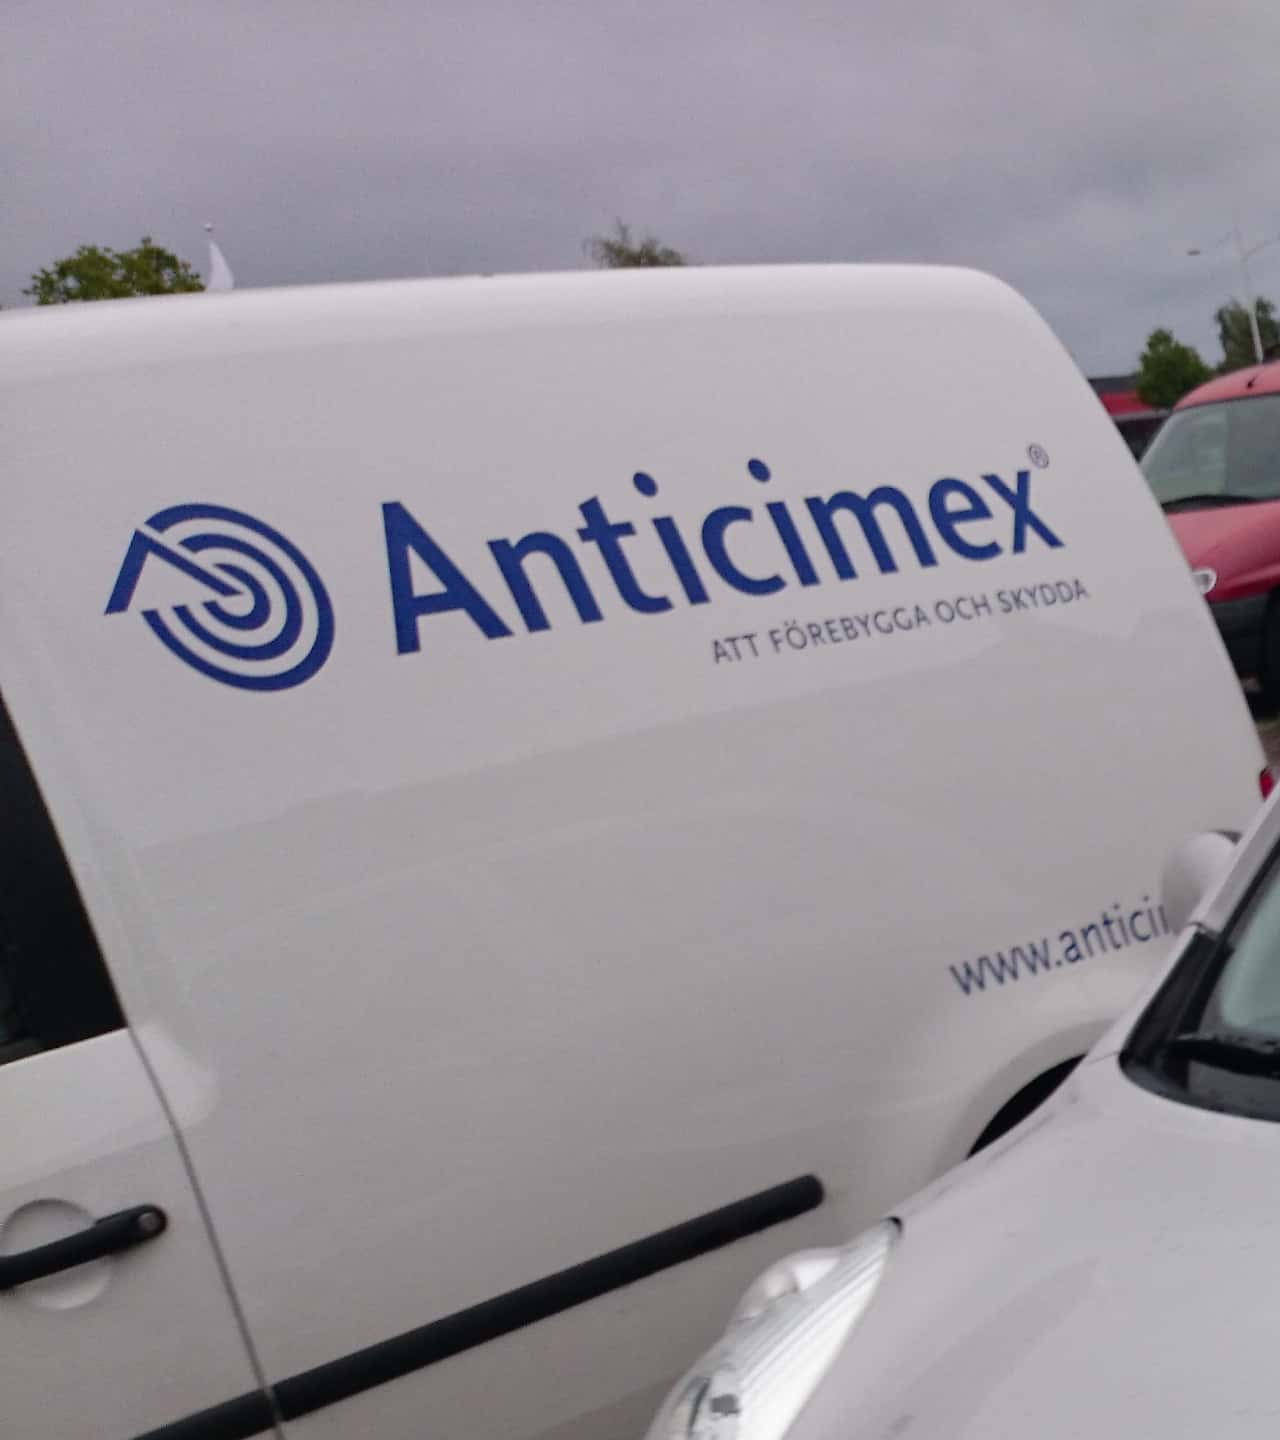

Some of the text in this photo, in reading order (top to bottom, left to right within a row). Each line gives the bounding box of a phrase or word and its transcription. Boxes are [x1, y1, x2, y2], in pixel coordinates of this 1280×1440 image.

[711, 578, 1091, 664] ATT FÖREBYGGA OCH SKYDDA
[949, 896, 1170, 995] www.antici
